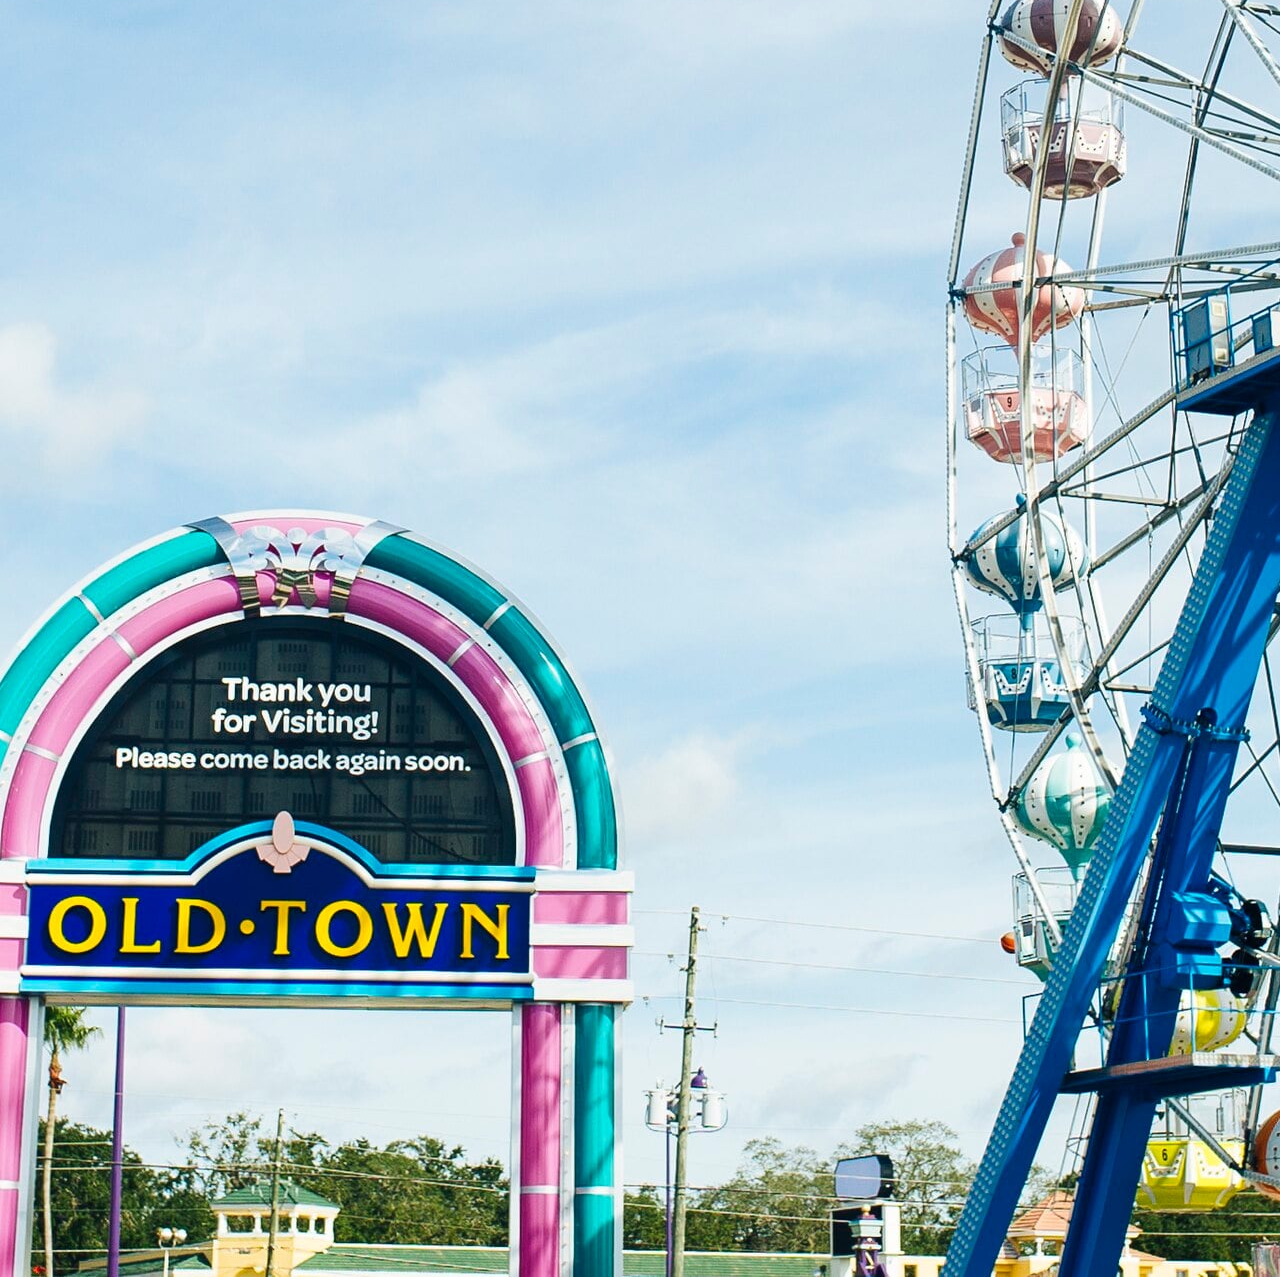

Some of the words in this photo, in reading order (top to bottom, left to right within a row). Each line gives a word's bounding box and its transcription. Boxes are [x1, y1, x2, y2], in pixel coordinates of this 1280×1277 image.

[1007, 396, 1012, 408] 9
[221, 676, 314, 702] Thank
[317, 683, 372, 709] you
[211, 707, 257, 733] for
[259, 708, 380, 741] Visiting!
[116, 746, 197, 769] Please
[200, 753, 269, 770] come
[273, 749, 332, 771] back
[335, 752, 402, 776] again
[404, 755, 471, 771] soon.
[1162, 1148, 1168, 1161] 6
